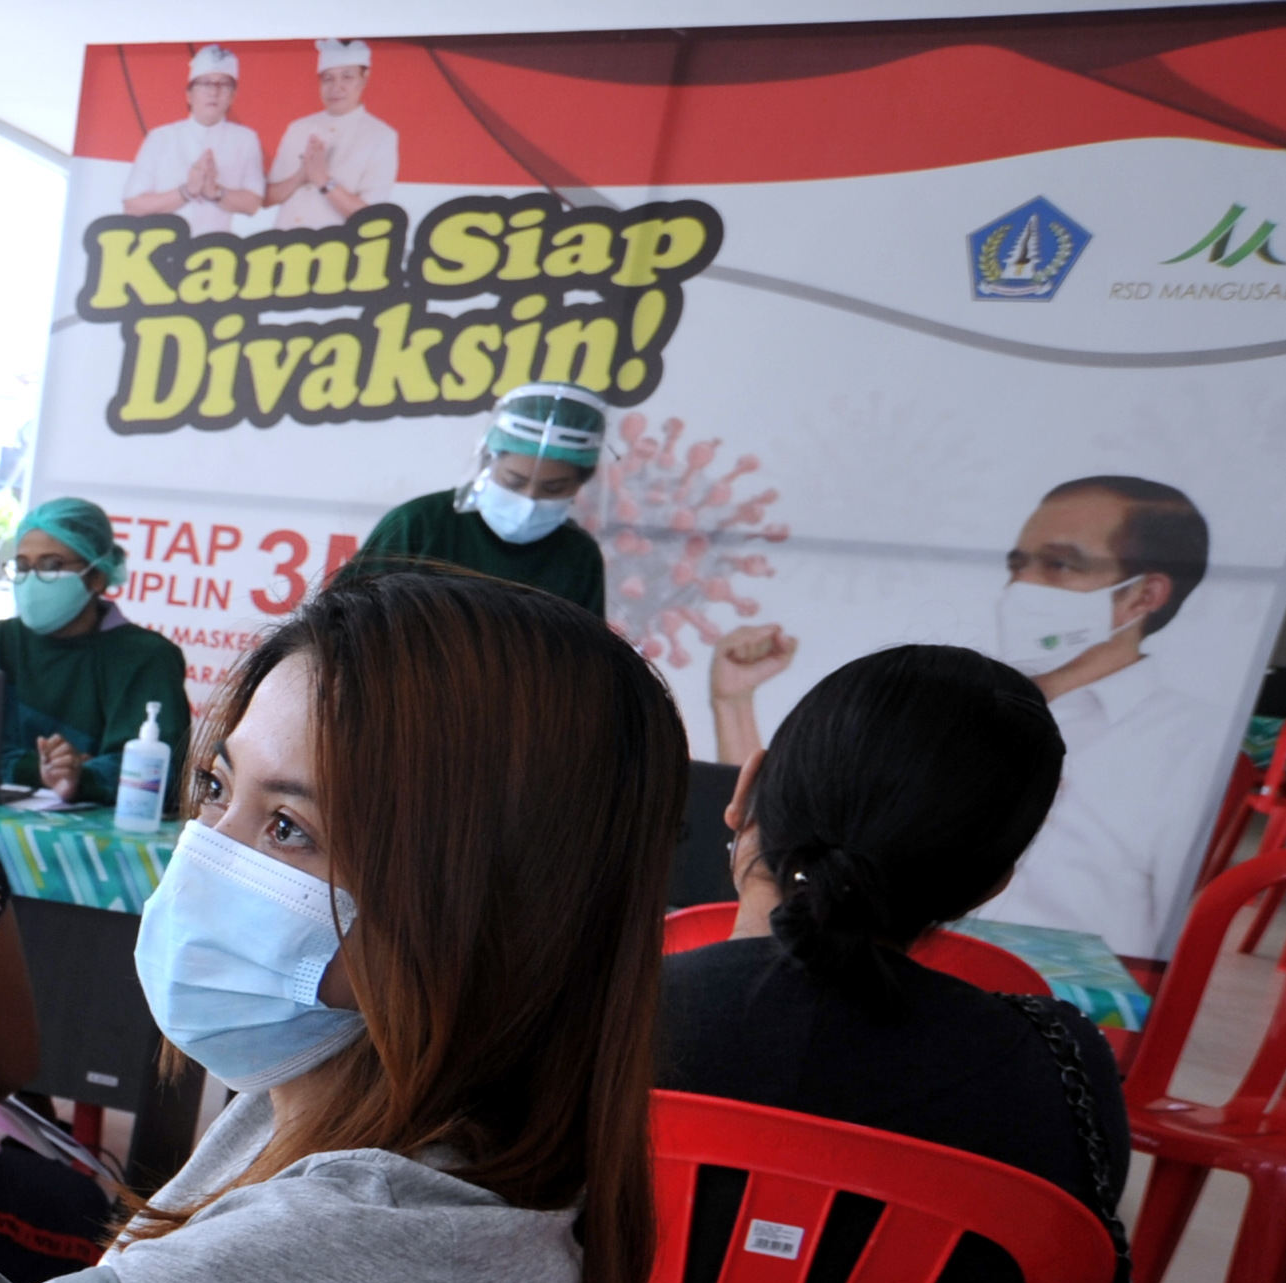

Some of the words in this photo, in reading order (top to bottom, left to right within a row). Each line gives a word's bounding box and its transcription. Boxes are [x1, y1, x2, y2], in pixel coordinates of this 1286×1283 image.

[89, 219, 393, 308] Kami
[421, 208, 706, 287] Siap
[1109, 282, 1154, 301] RSD
[1159, 280, 1286, 302] MANGUSA
[119, 288, 667, 422] Divaksin!
